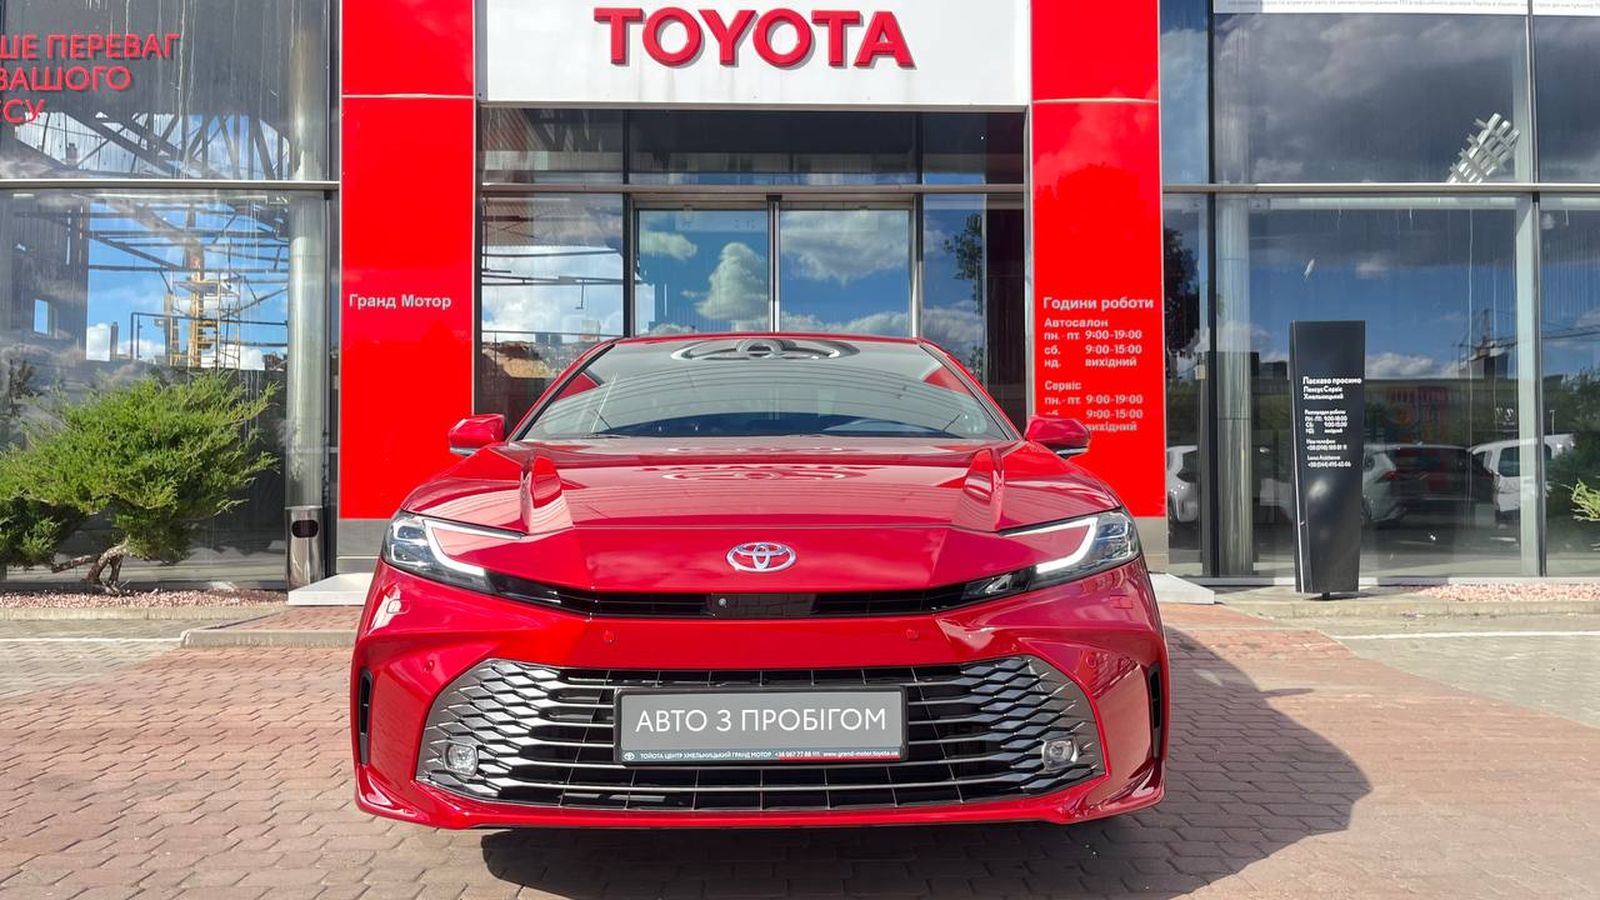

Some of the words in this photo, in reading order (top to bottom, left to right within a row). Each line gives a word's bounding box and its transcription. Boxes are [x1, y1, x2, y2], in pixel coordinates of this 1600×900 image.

[593, 6, 917, 69] TOYOTA
[47, 33, 181, 59] ПЕРЕВАГ
[0, 98, 46, 125] СУ
[349, 293, 397, 310] Гранд
[401, 293, 452, 311] Мотор
[1043, 296, 1097, 311] Години
[1101, 296, 1154, 312] роботи
[1044, 317, 1109, 328] Автосалон
[1085, 330, 1142, 340] 9:00-19:00
[1044, 345, 1061, 355] сб.
[1085, 344, 1142, 354] 9:00-15:00
[1044, 359, 1061, 369] нд.
[1085, 356, 1137, 368] вихідний
[1044, 380, 1082, 392] Сервіс
[1332, 377, 1362, 386] просимо
[1323, 386, 1343, 394] Сервіс
[1086, 395, 1143, 405] 9:00-19:00
[1086, 409, 1143, 419] 9:00-15:00
[635, 709, 708, 733] АВТО
[716, 708, 733, 732] З
[741, 707, 887, 732] ПРОБІГОМ
[640, 752, 665, 760] ТОЙОТА
[665, 752, 683, 760] ЦЕНТР
[684, 751, 731, 760] ХМЕЛЬНИЦЬКИЙ
[732, 751, 751, 760] ГРАНД
[751, 751, 772, 760] МОТОР
